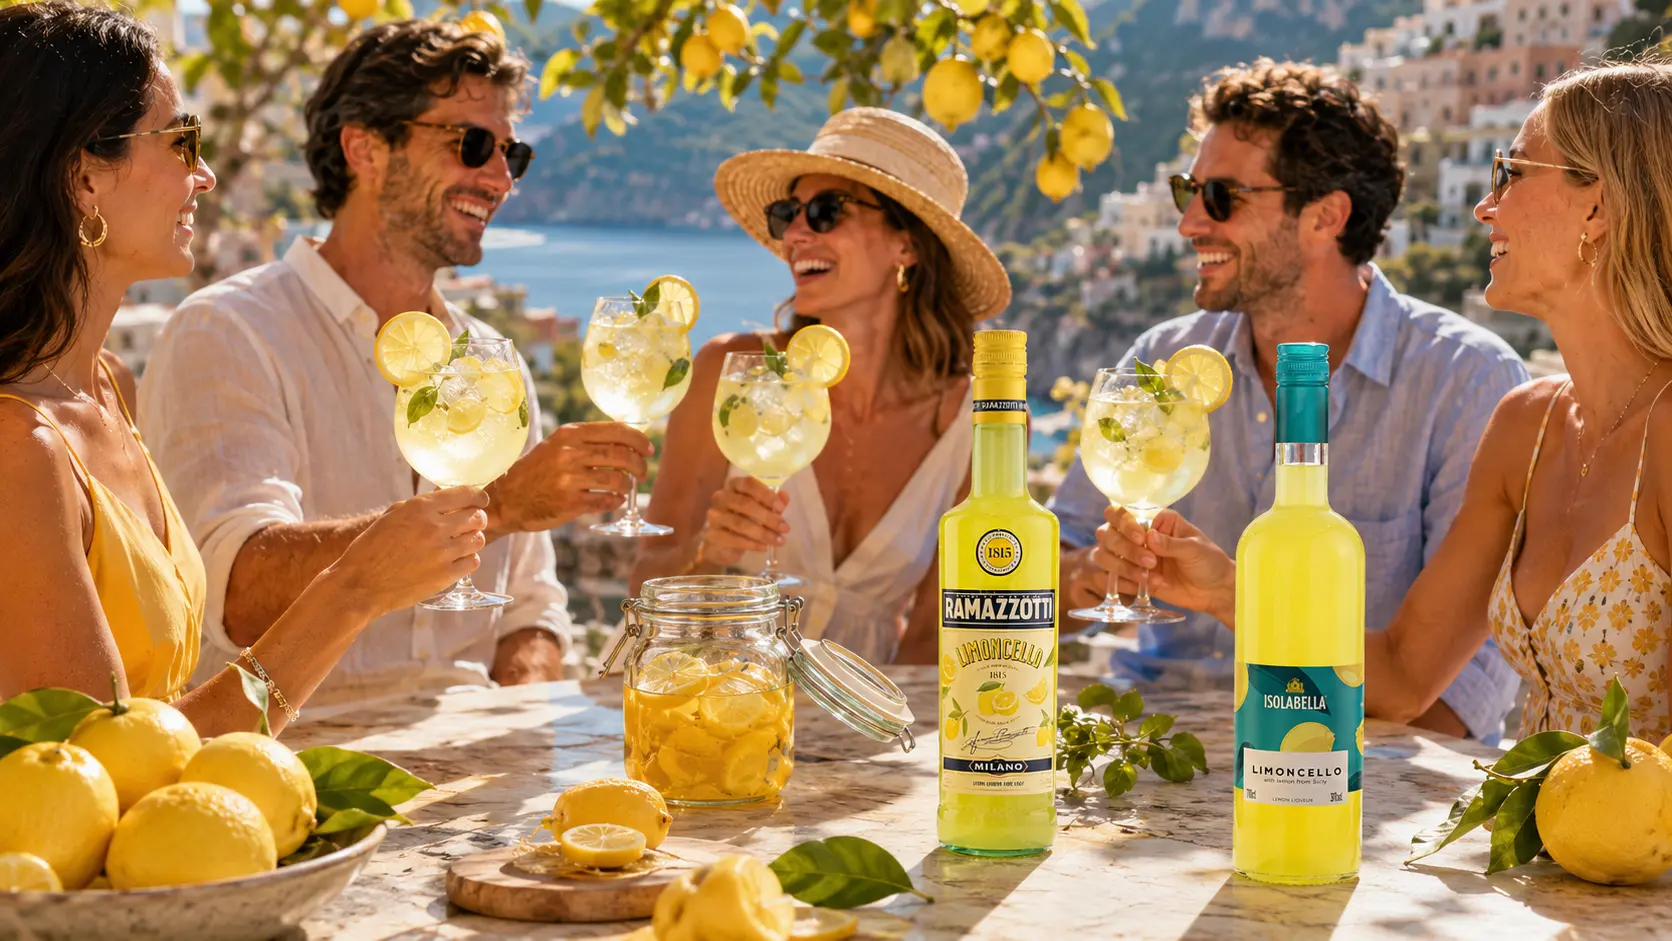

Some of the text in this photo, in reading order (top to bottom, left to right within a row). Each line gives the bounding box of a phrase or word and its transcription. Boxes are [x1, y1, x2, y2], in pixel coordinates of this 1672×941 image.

[988, 547, 1012, 559] 1815
[945, 597, 1053, 620] RAMAZZOTTI
[955, 638, 1043, 669] LIMONCELLO
[989, 671, 1007, 679] 1815
[1264, 694, 1326, 710] ISOLABELLA
[974, 762, 1023, 771] MILANO
[1252, 765, 1342, 777] LIMONCELLO
